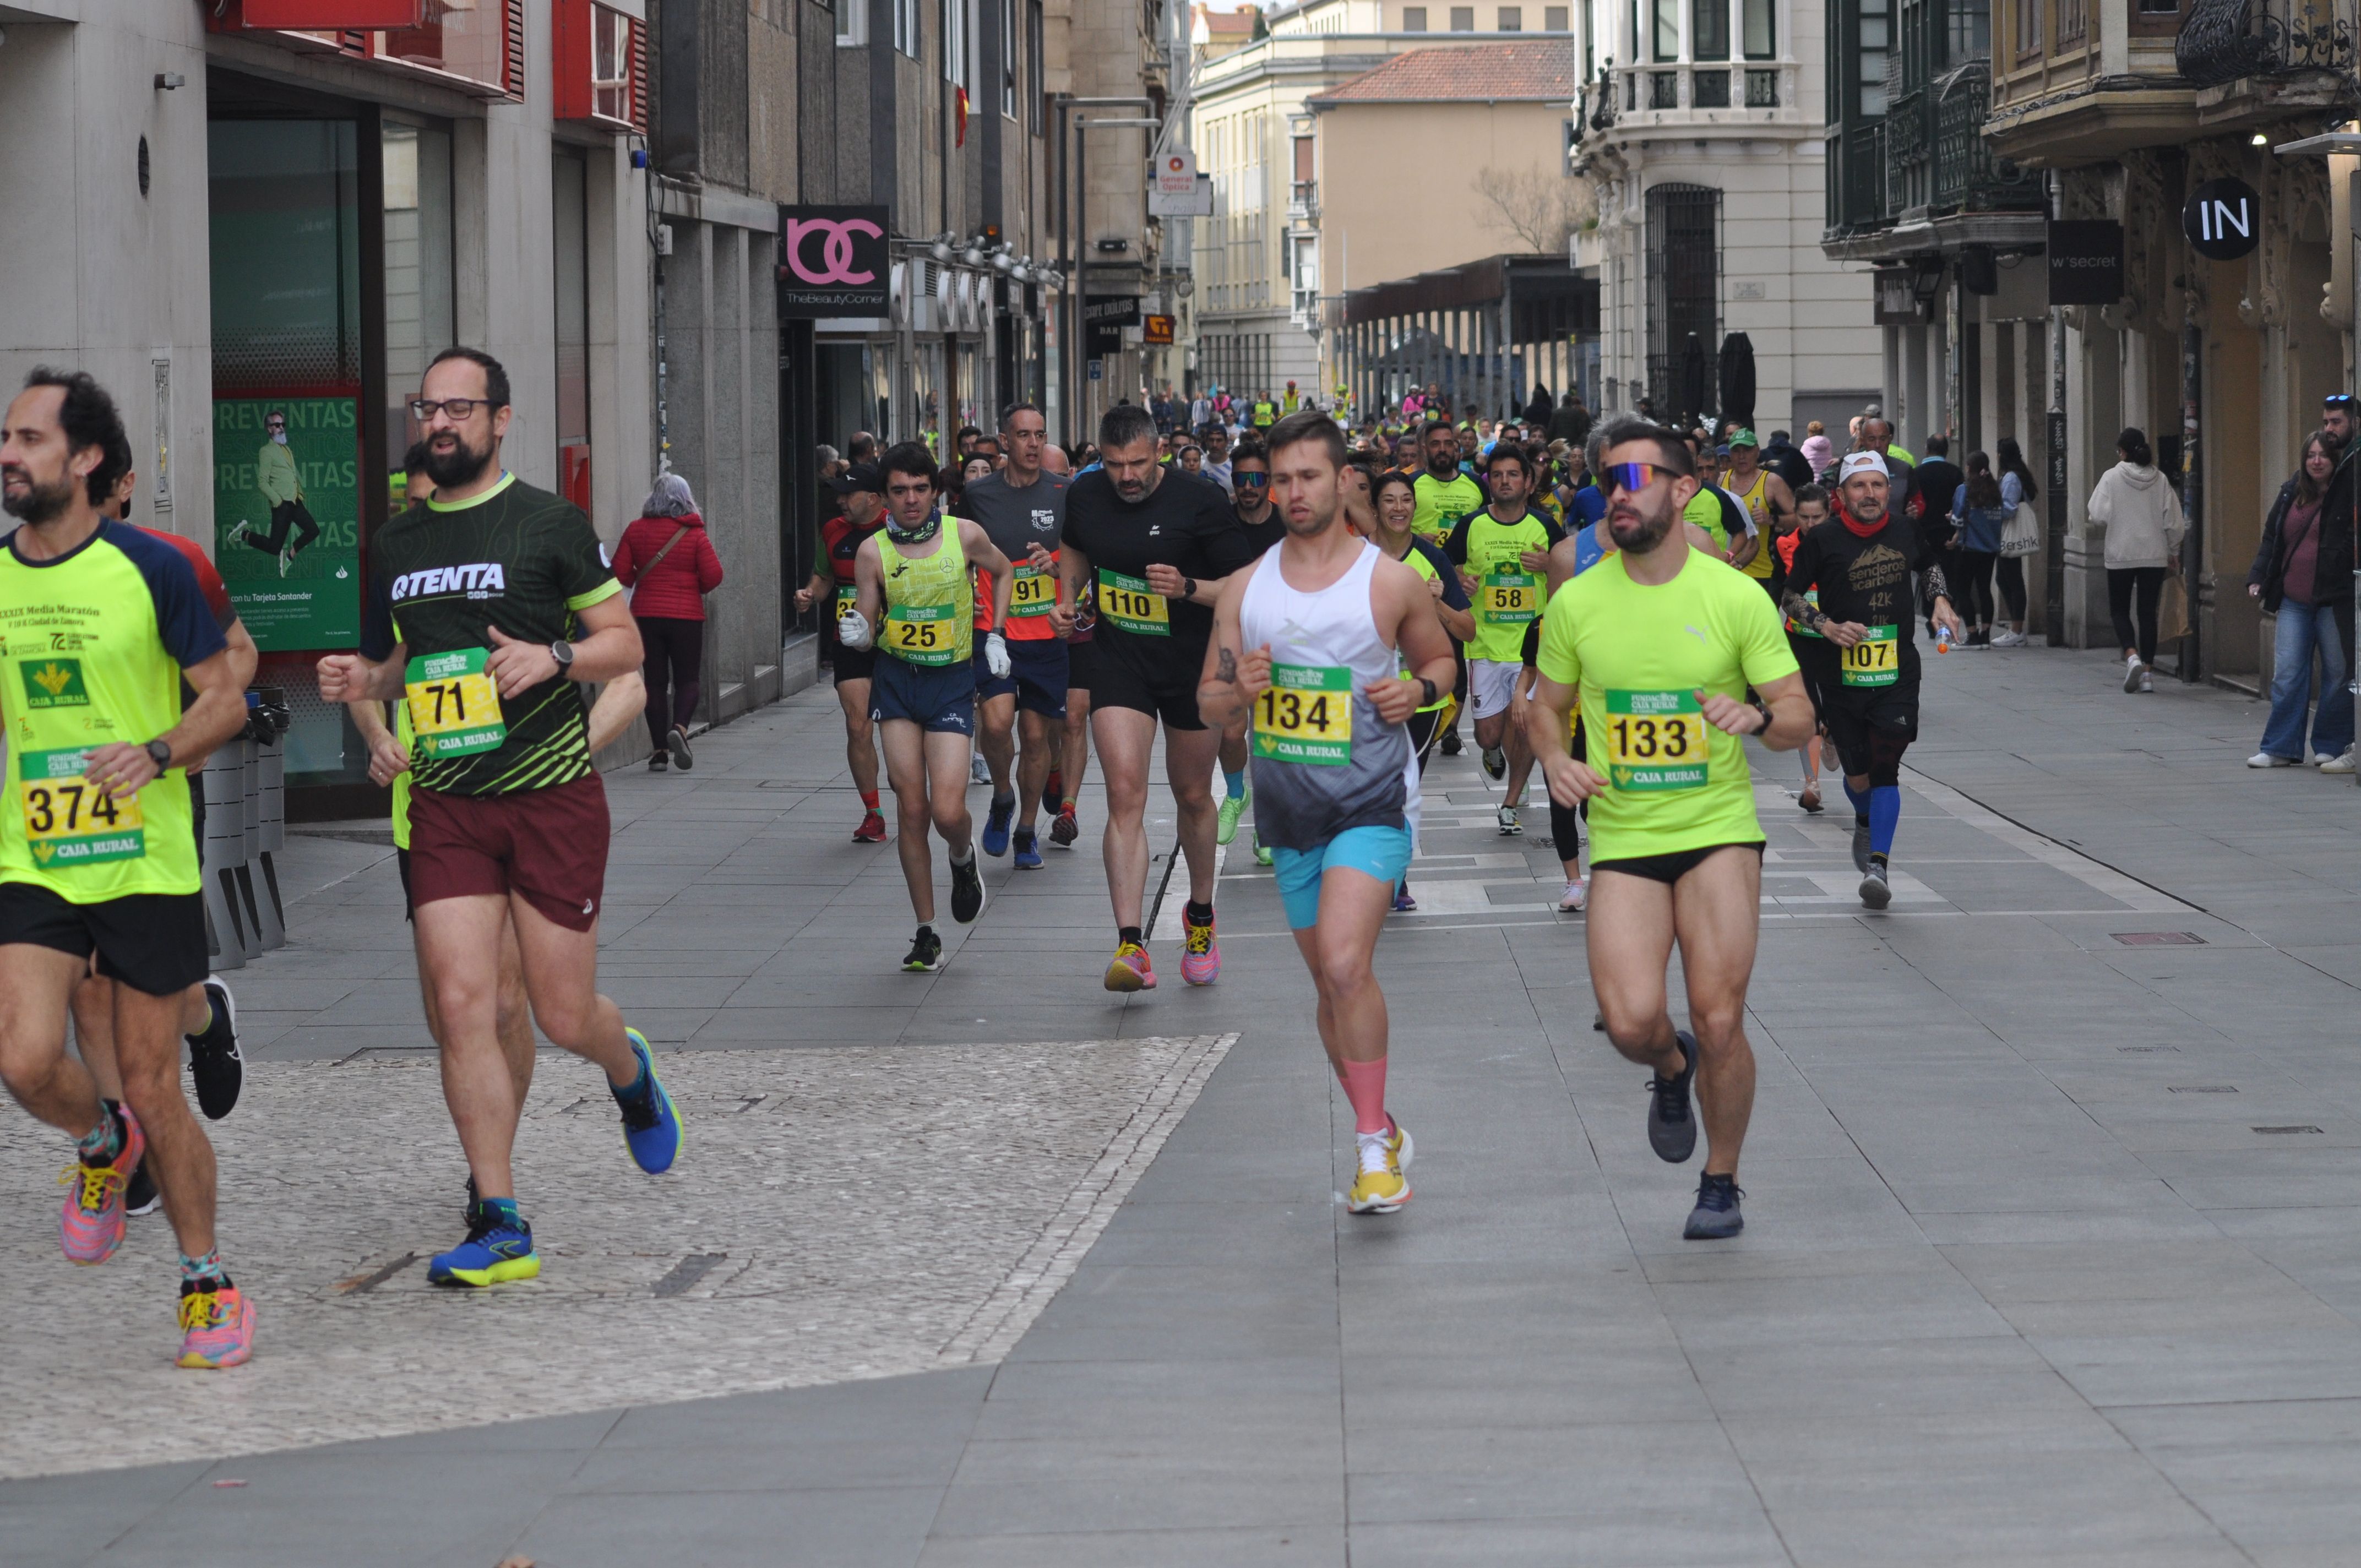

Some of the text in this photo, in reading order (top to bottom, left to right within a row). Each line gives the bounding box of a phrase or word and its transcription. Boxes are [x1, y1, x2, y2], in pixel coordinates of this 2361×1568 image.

[2201, 198, 2249, 240] IN
[787, 293, 883, 305] TheBeautyCorner
[1100, 326, 1118, 335] BAR
[1848, 560, 1905, 581] senderos
[252, 593, 276, 603] Tarjeta
[277, 592, 312, 600] Santander
[1016, 579, 1040, 600] 91
[1495, 589, 1522, 607] 58
[26, 605, 54, 615] Media
[57, 605, 100, 616] Maratón
[1106, 590, 1151, 617] 110
[1868, 592, 1892, 611] 42K
[28, 617, 50, 625] Ciudad
[60, 617, 85, 625] Zamora
[1120, 621, 1166, 632] CAJA RURAL
[901, 624, 935, 647] 25
[1846, 644, 1887, 667] 107
[443, 662, 467, 673] RURAL
[1279, 676, 1296, 684] CAJA
[1297, 677, 1323, 686] RURAL
[426, 682, 465, 724] 71
[1261, 690, 1330, 732] 134
[1631, 701, 1678, 709] CAJA RURAL
[438, 731, 503, 749] CAJA RURAL
[1613, 719, 1687, 758] 133
[1278, 742, 1345, 758] CAJA RURAL
[48, 761, 67, 771] CAJA
[1634, 770, 1703, 783] CAJA RURAL
[29, 786, 119, 832] 374
[57, 838, 140, 858] CAJA RURAL
